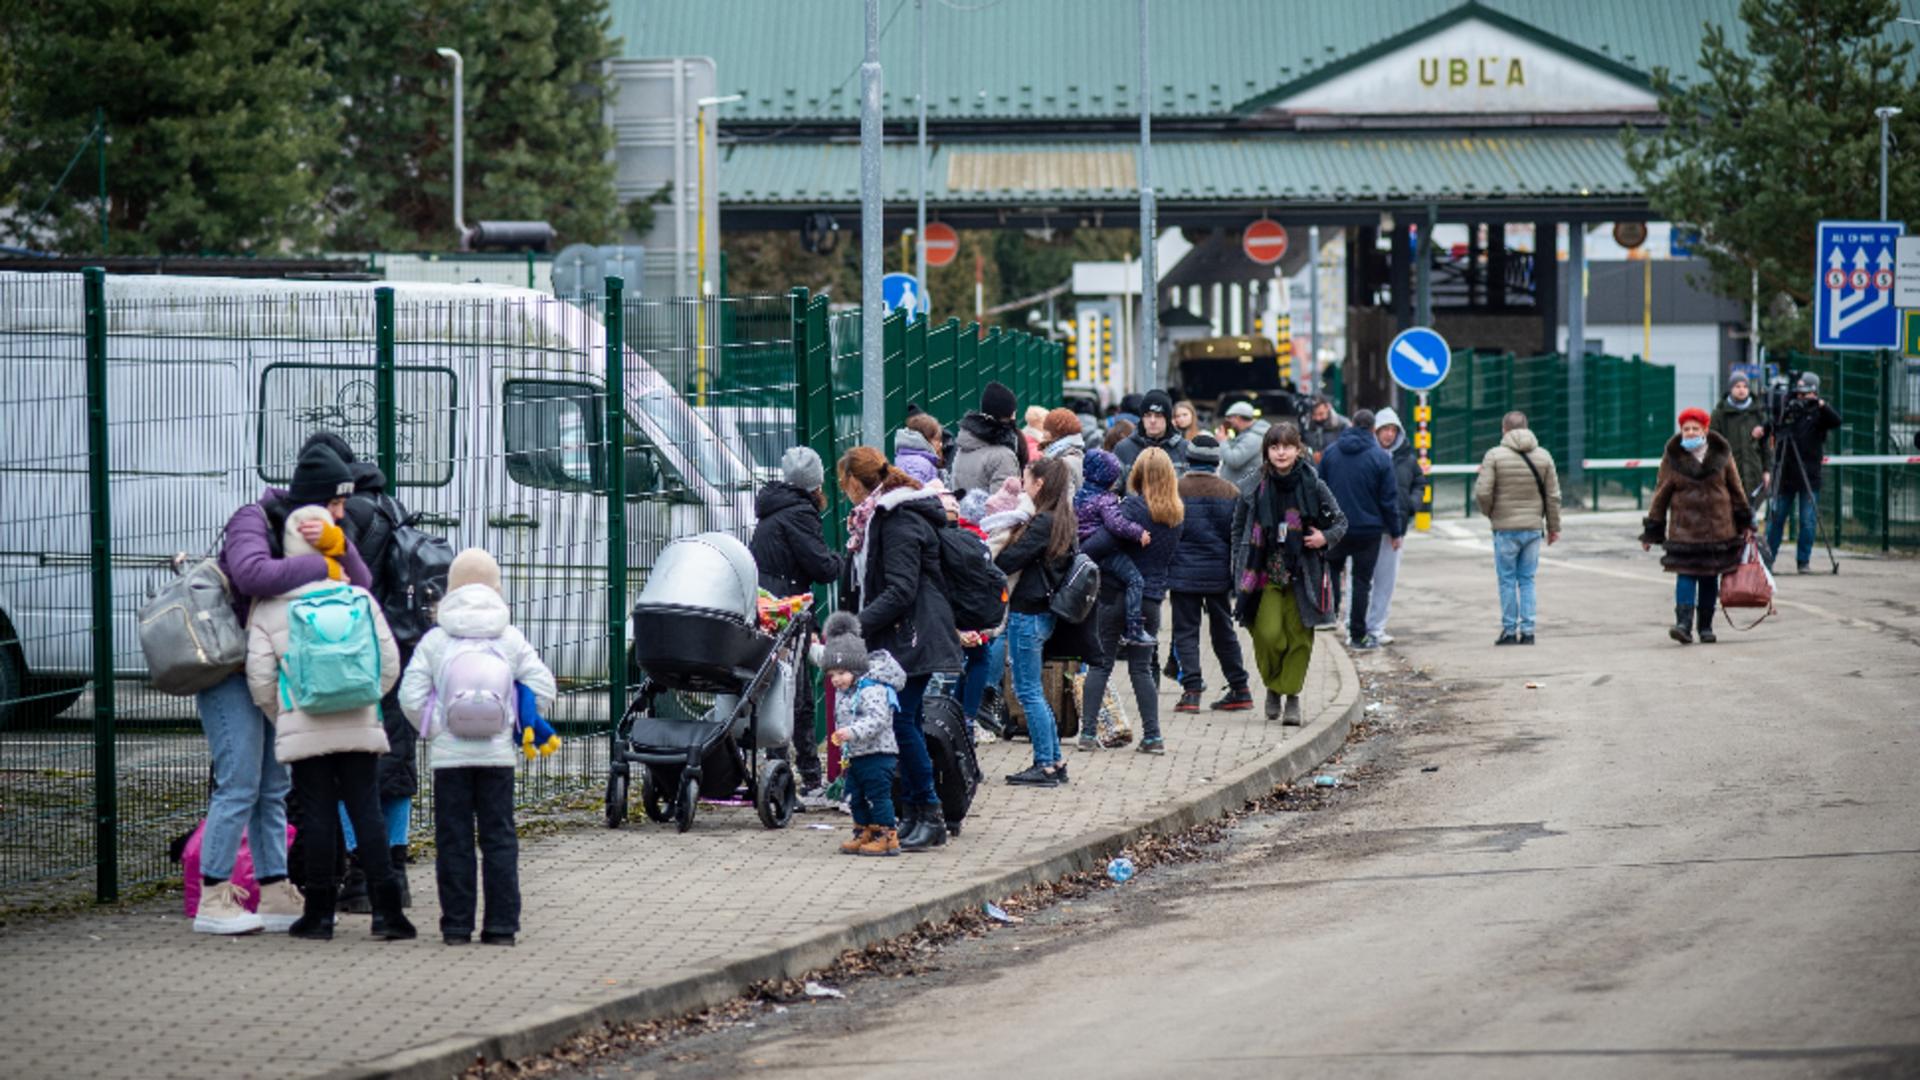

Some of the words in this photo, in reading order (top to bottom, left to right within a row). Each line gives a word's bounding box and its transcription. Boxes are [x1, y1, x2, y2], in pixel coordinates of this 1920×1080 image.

[1832, 273, 1839, 285] 5
[1857, 274, 1863, 285] 5
[1881, 274, 1888, 285] 5
